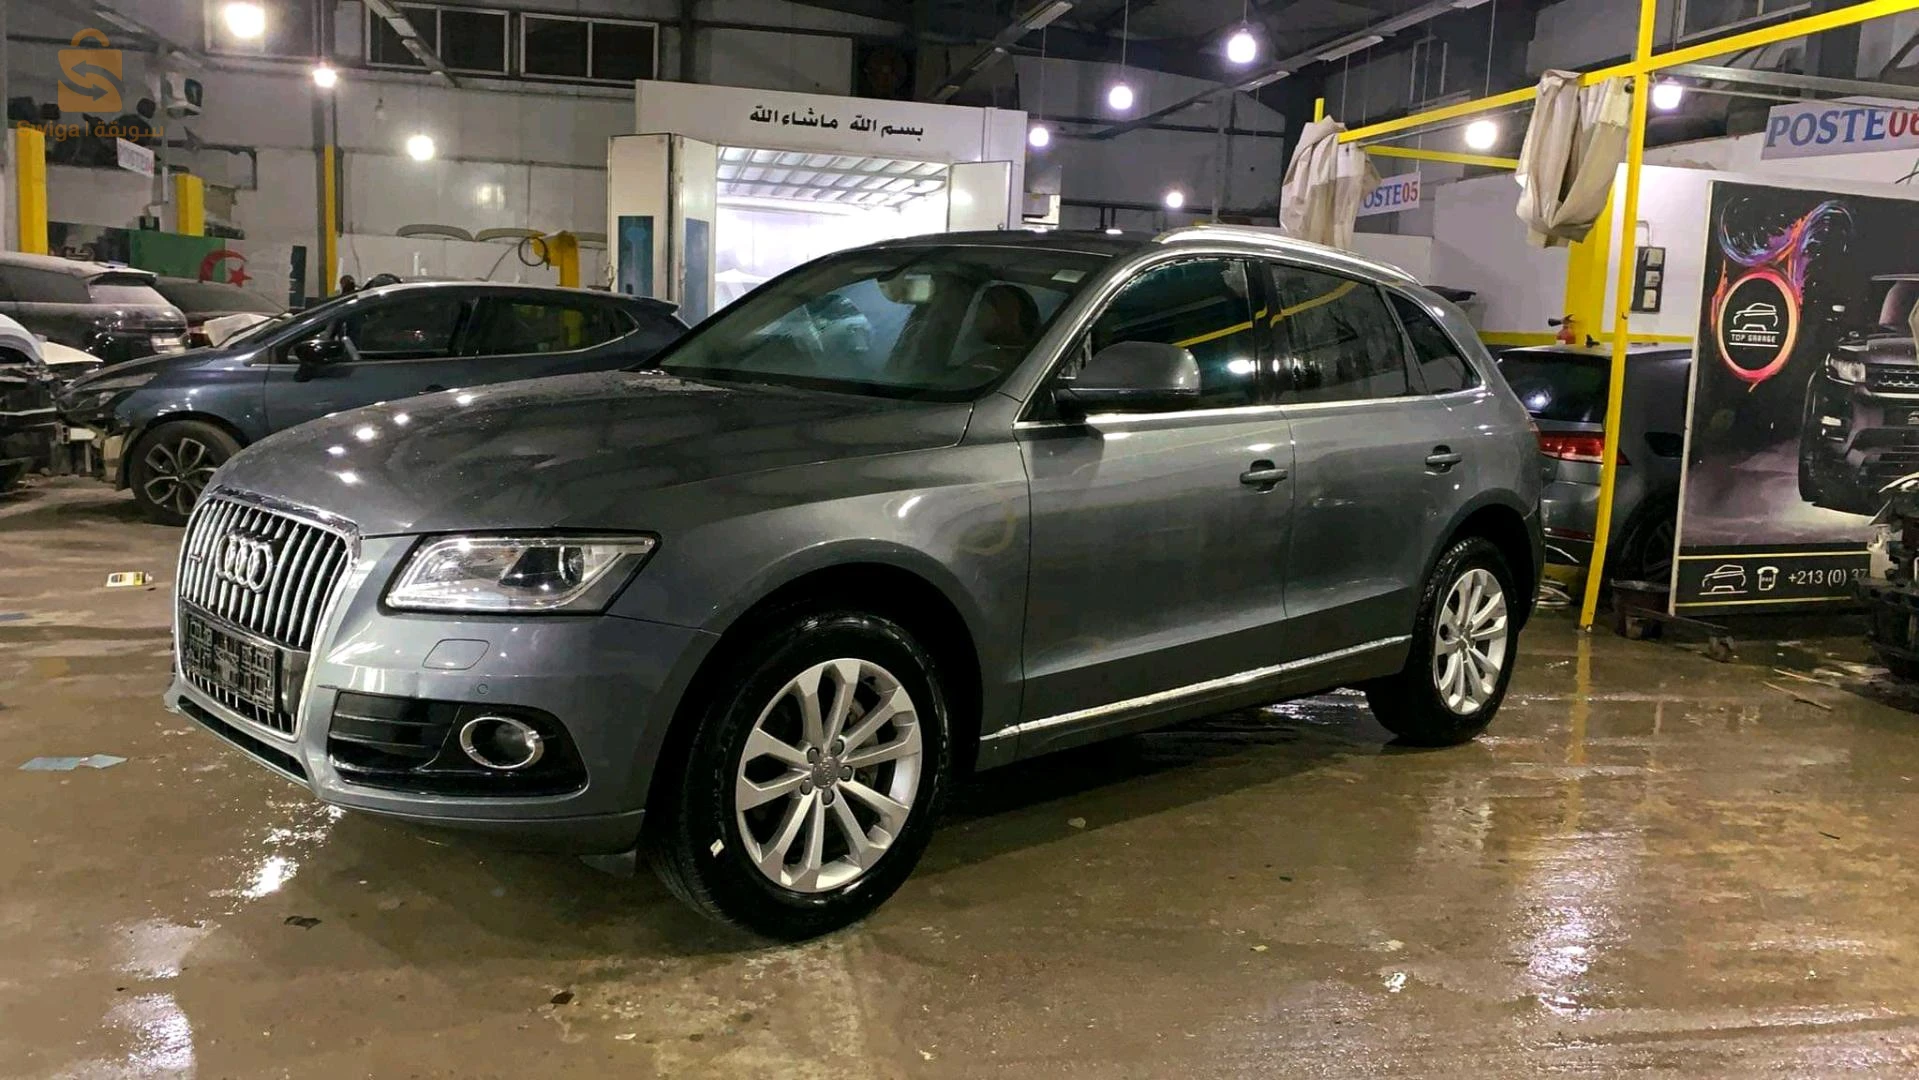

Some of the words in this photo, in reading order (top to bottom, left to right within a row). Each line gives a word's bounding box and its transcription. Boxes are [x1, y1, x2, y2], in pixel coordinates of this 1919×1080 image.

[782, 107, 839, 129] ماشاء
[881, 126, 924, 142] بسم
[1363, 181, 1419, 209] OSTE05
[1731, 333, 1746, 342] TOP
[1788, 569, 1824, 585] +213
[1827, 568, 1847, 587] (0)
